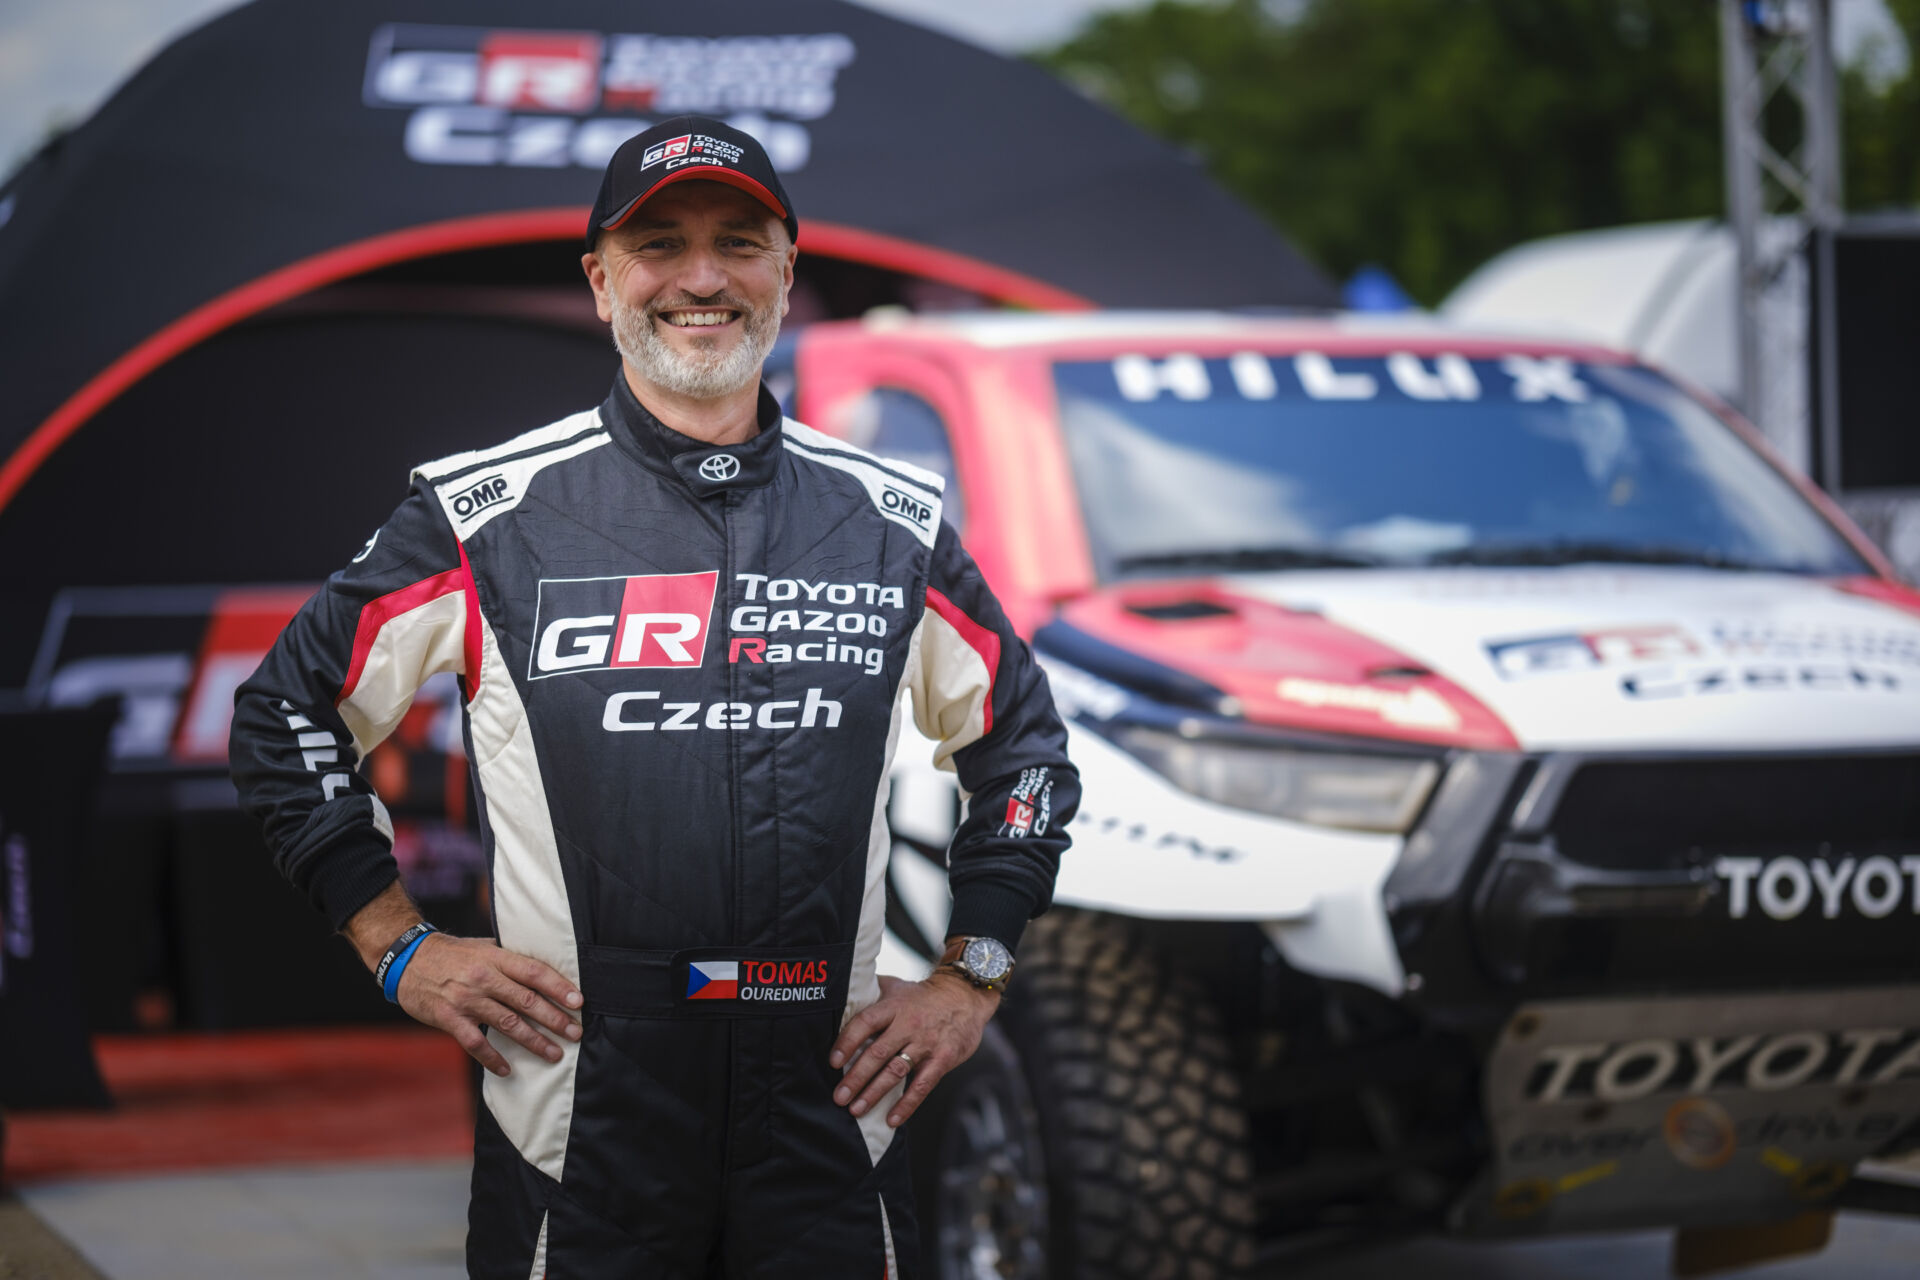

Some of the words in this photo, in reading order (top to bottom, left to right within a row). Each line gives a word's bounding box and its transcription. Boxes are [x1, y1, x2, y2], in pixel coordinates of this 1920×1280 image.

[404, 106, 812, 172] Czeh
[644, 141, 686, 165] GR
[691, 146, 739, 164] Racing
[692, 140, 741, 158] GAZOO
[694, 134, 745, 154] TOYOTA
[665, 156, 723, 170] Czech
[1112, 350, 1590, 402] HILUX
[453, 478, 508, 516] OMP
[882, 489, 931, 523] OMP
[735, 573, 905, 609] TOYOTA
[729, 605, 888, 638] GAZOO
[537, 612, 702, 672] GR
[728, 636, 884, 676] Racing
[602, 687, 843, 732] Czech
[742, 960, 828, 985] TOMAS
[740, 986, 827, 1001] OUREDNICEK
